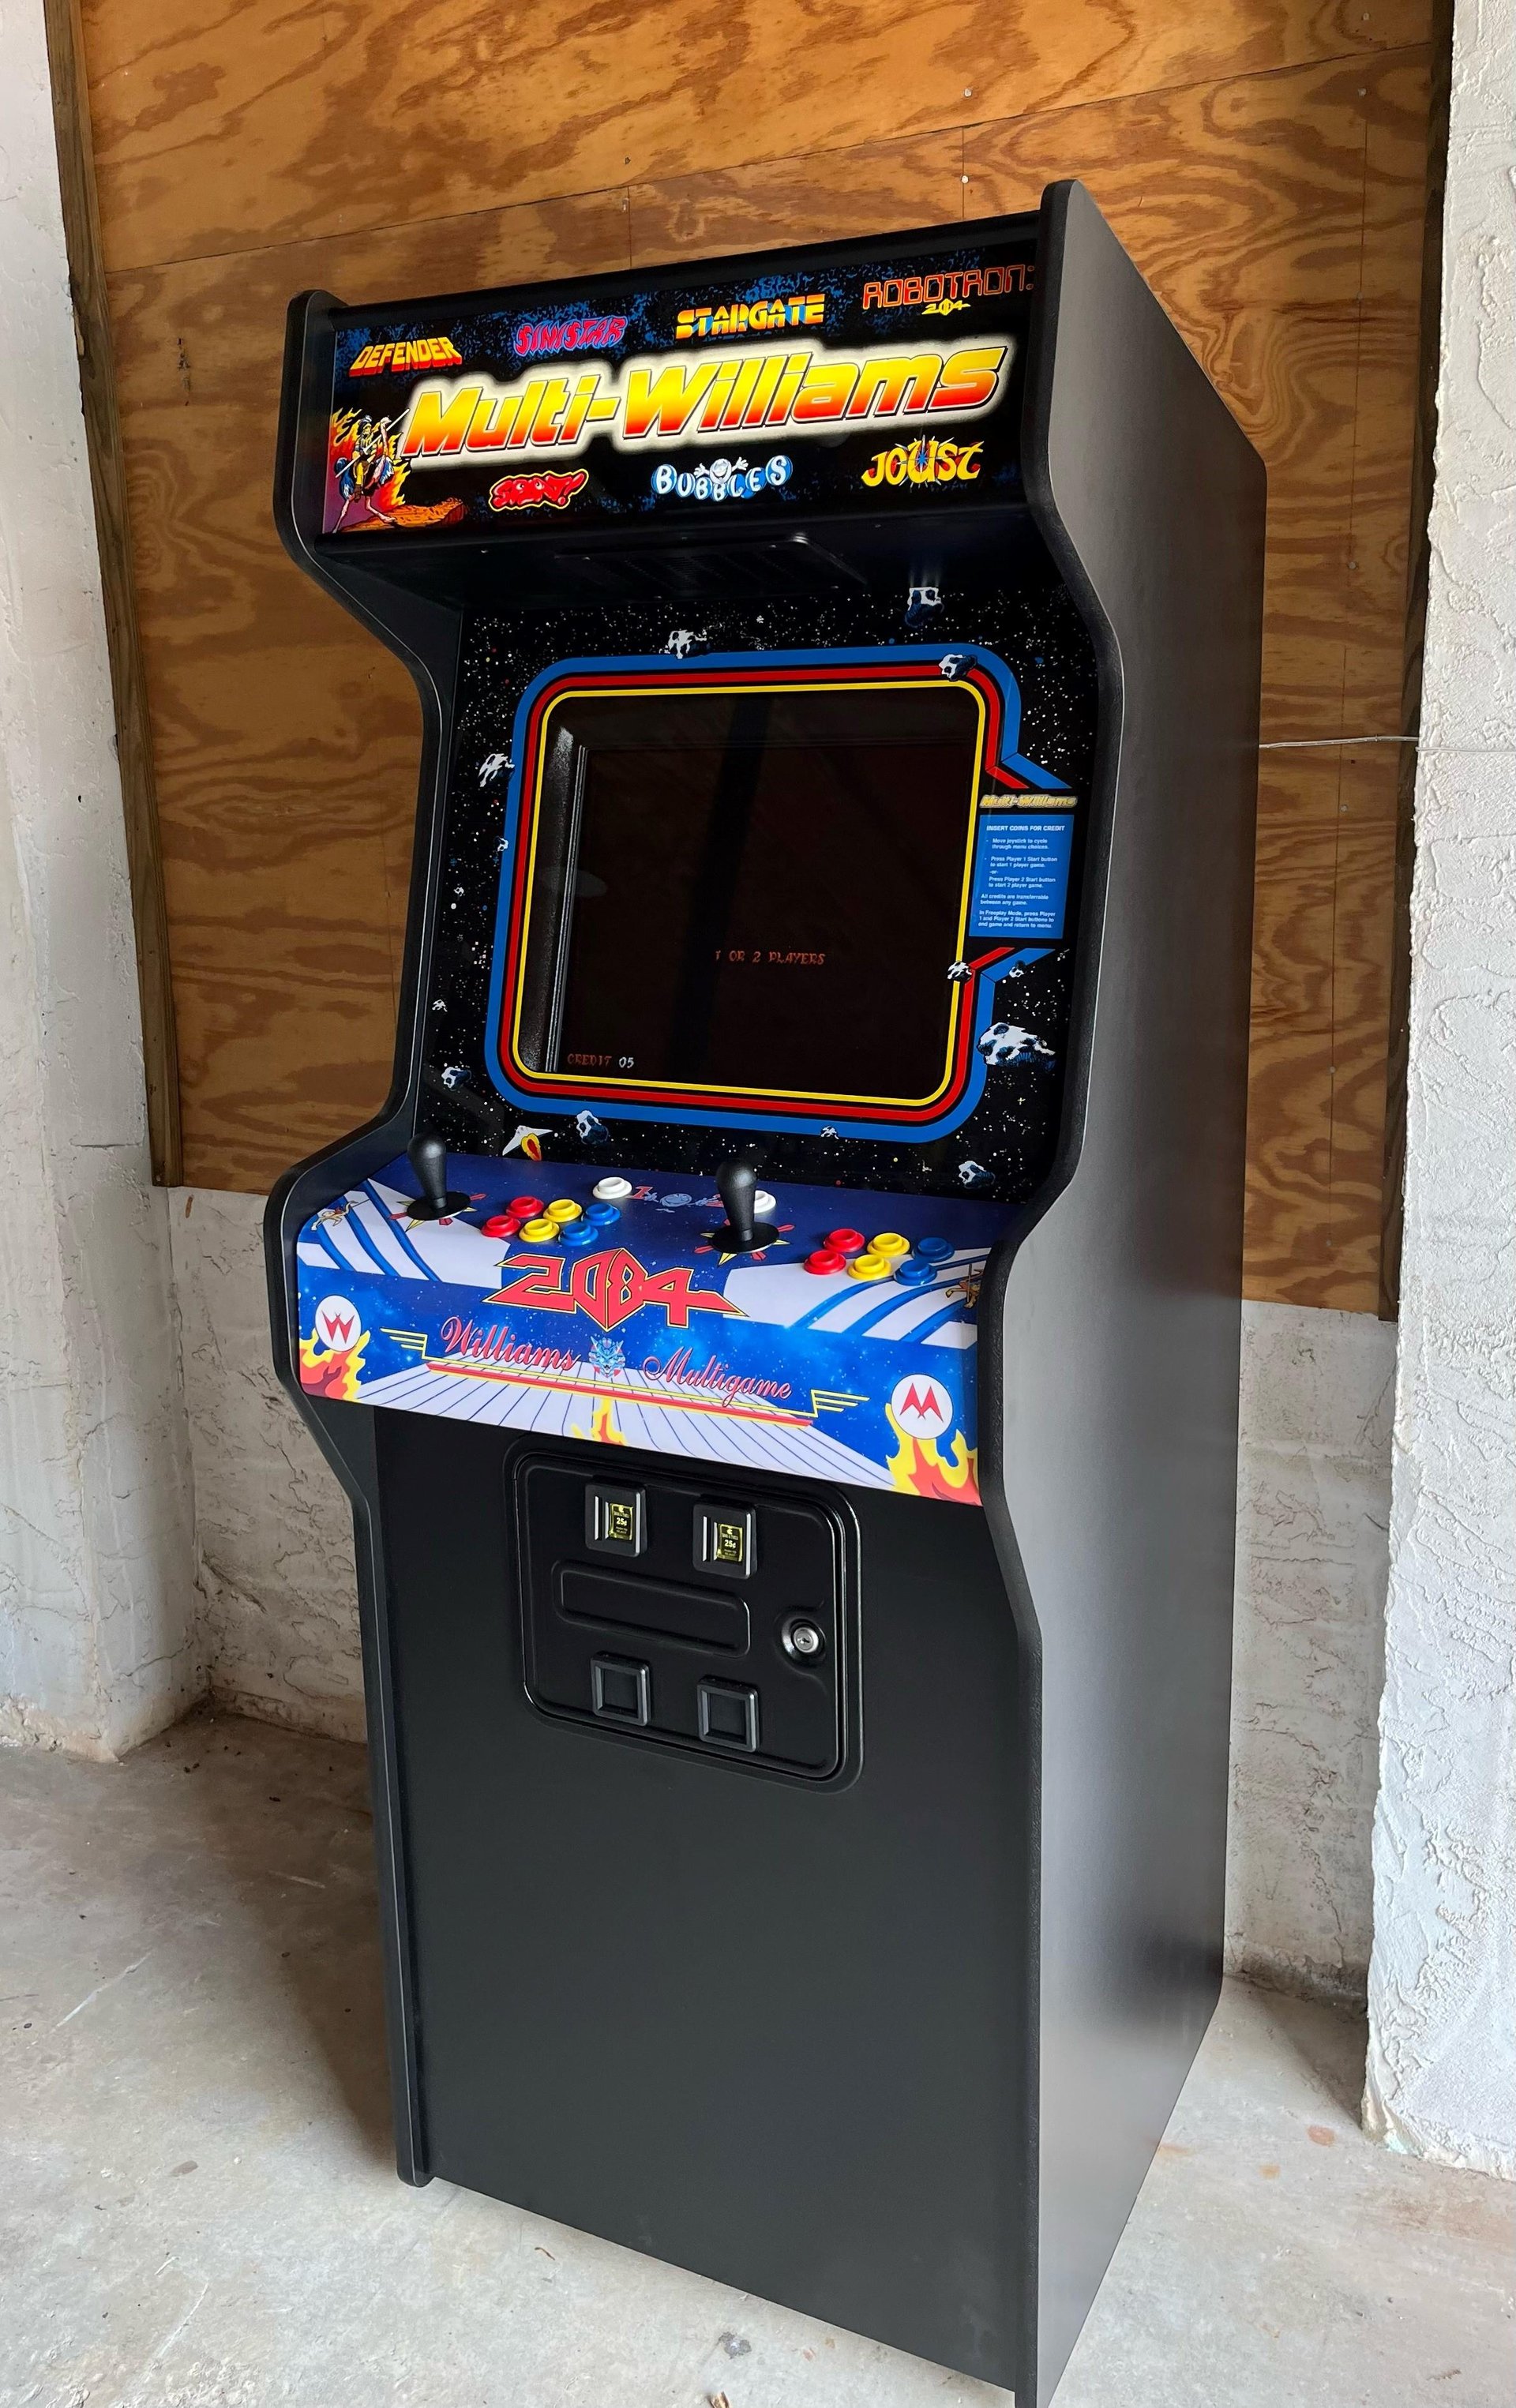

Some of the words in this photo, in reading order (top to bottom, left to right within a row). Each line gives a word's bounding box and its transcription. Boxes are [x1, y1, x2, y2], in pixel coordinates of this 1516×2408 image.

[862, 264, 1034, 309] ROBOTRON:
[514, 316, 628, 356] SINISTAR
[676, 294, 825, 339] STARGATE
[349, 336, 463, 377] DEFENDER
[400, 345, 1008, 459] Multi-Williams
[652, 455, 793, 501] BUBBLES
[981, 795, 1076, 807] Multi-Williams
[729, 951, 745, 962] OR
[752, 951, 761, 963] 2
[768, 951, 826, 966] PLAYERS
[567, 1053, 613, 1067] CREDIT
[618, 1056, 635, 1069] 05
[482, 1247, 749, 1332] 2084
[440, 1316, 582, 1371] Williams
[642, 1347, 793, 1408] Multigame
